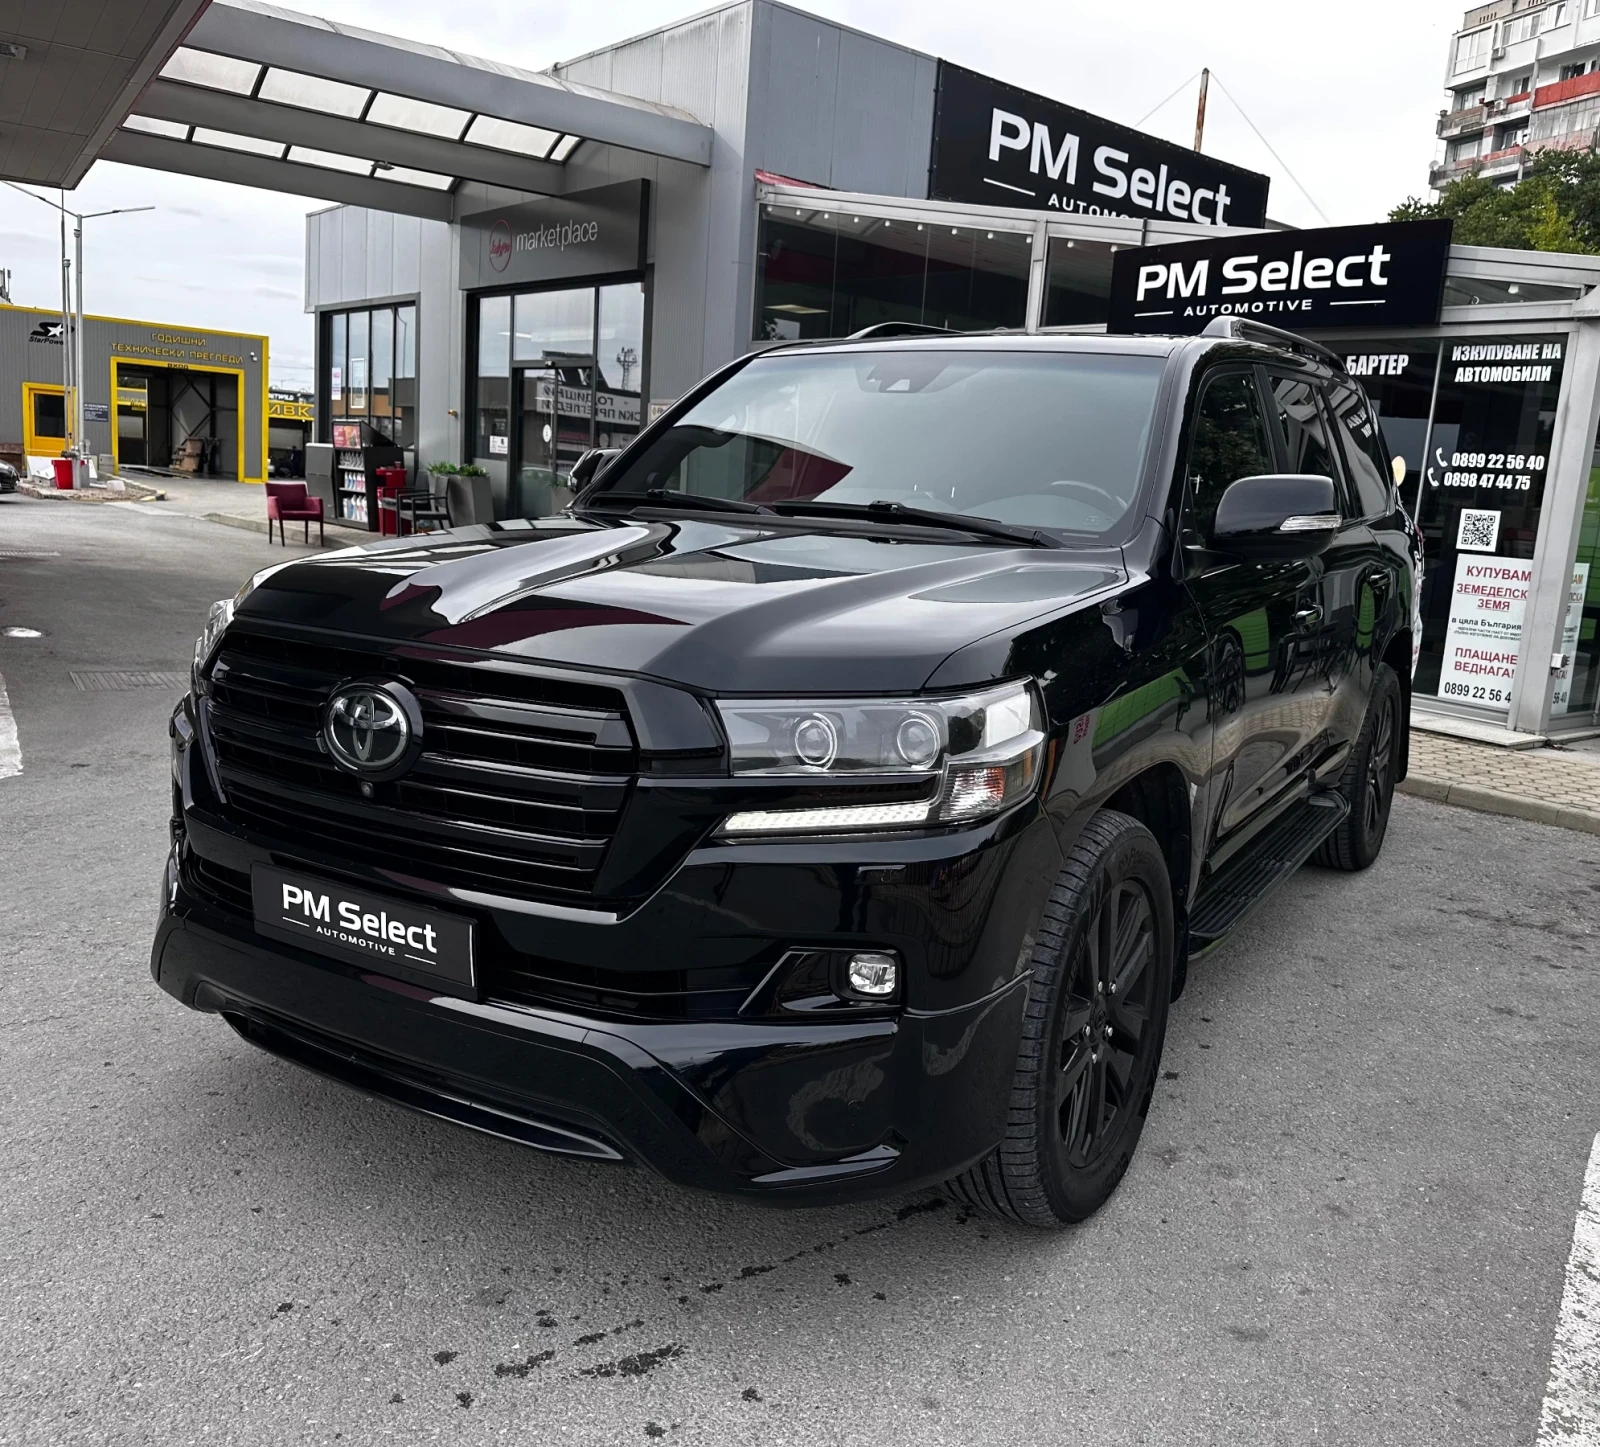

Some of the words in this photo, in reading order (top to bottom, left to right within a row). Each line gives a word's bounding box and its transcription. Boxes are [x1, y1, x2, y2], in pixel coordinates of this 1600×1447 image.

[988, 107, 1080, 186] PM
[1092, 145, 1231, 227] Select
[516, 219, 598, 252] marketplace
[1136, 260, 1209, 302] PM
[1221, 245, 1391, 295] Select
[1183, 299, 1313, 317] AUTOMOTIVE
[28, 336, 65, 346] StarPowe
[151, 333, 206, 346] ГОДИШНИ
[110, 342, 185, 358] ТЕХНИЧЕСКИ
[189, 351, 244, 364] ПРЕГЛЕДИ
[1451, 344, 1540, 362] ИЗКУПУВАНЕ
[1541, 343, 1562, 360] НА
[1345, 354, 1409, 376] БАРТЕР
[1454, 365, 1552, 383] АВТОМОБИЛИ
[1451, 452, 1486, 468] 0899
[1487, 454, 1505, 469] 22
[1506, 455, 1525, 470] 56
[1526, 455, 1545, 471] 40
[1443, 472, 1478, 488] 0898
[1478, 474, 1495, 489] 47
[1495, 474, 1513, 490] 44
[1514, 475, 1531, 491] 75
[1466, 565, 1532, 582] КУПУВАМ
[1456, 583, 1528, 599] ЗЕМЕДЕЛСК
[1477, 598, 1511, 611] ЗЕМЯ
[1458, 618, 1479, 626] цяла
[1480, 619, 1522, 630] България
[1455, 647, 1518, 665] ПЛАЩАНЕ
[1454, 661, 1515, 679] ВЕДНАГА!
[1444, 681, 1470, 697] 0899
[1472, 686, 1486, 699] 22
[1488, 688, 1502, 702] 56
[1504, 691, 1512, 704] 4
[282, 882, 331, 923] PM
[337, 900, 438, 954] Select
[316, 925, 396, 956] AUTOMOTIVE
